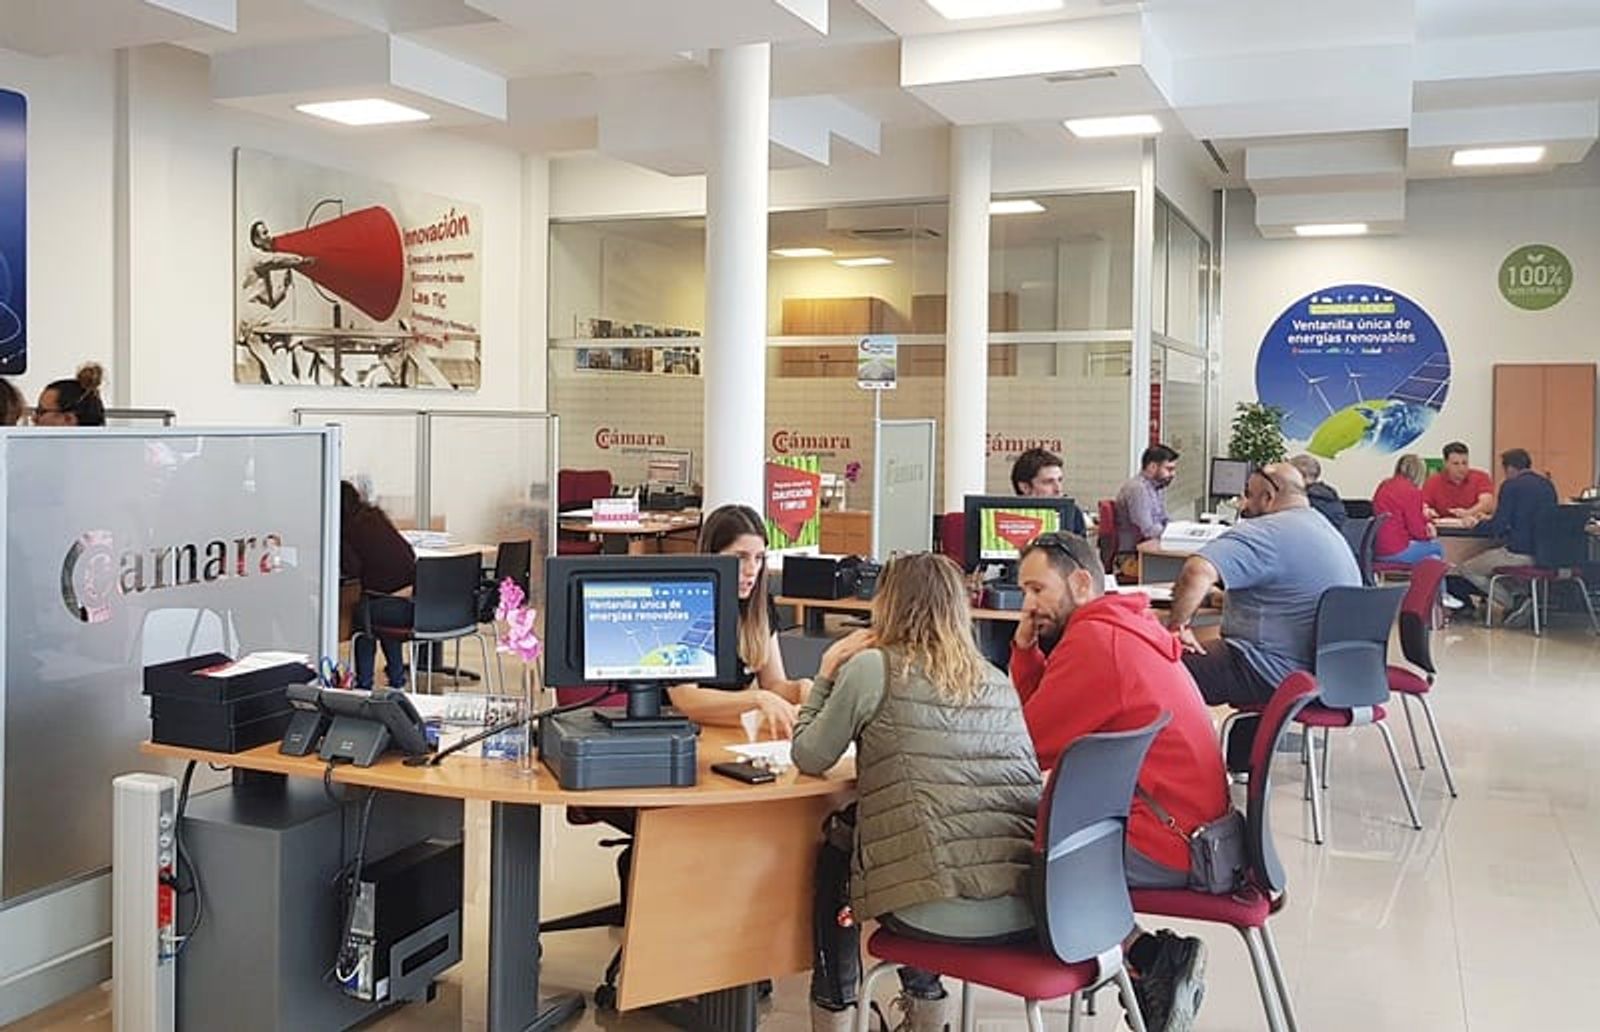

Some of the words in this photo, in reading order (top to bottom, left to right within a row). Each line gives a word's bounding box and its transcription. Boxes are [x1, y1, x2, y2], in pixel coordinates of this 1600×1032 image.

[1508, 265, 1562, 287] 100%
[412, 287, 429, 304] Las
[1292, 319, 1353, 331] Ventanilla
[1356, 317, 1391, 330] única
[1395, 318, 1412, 330] de
[1287, 331, 1342, 346] energías
[1345, 331, 1416, 344] renovables
[589, 600, 637, 610] Ventanilla
[640, 598, 667, 610] única
[669, 599, 681, 610] de
[589, 611, 633, 623] energías
[635, 611, 689, 622] renovables
